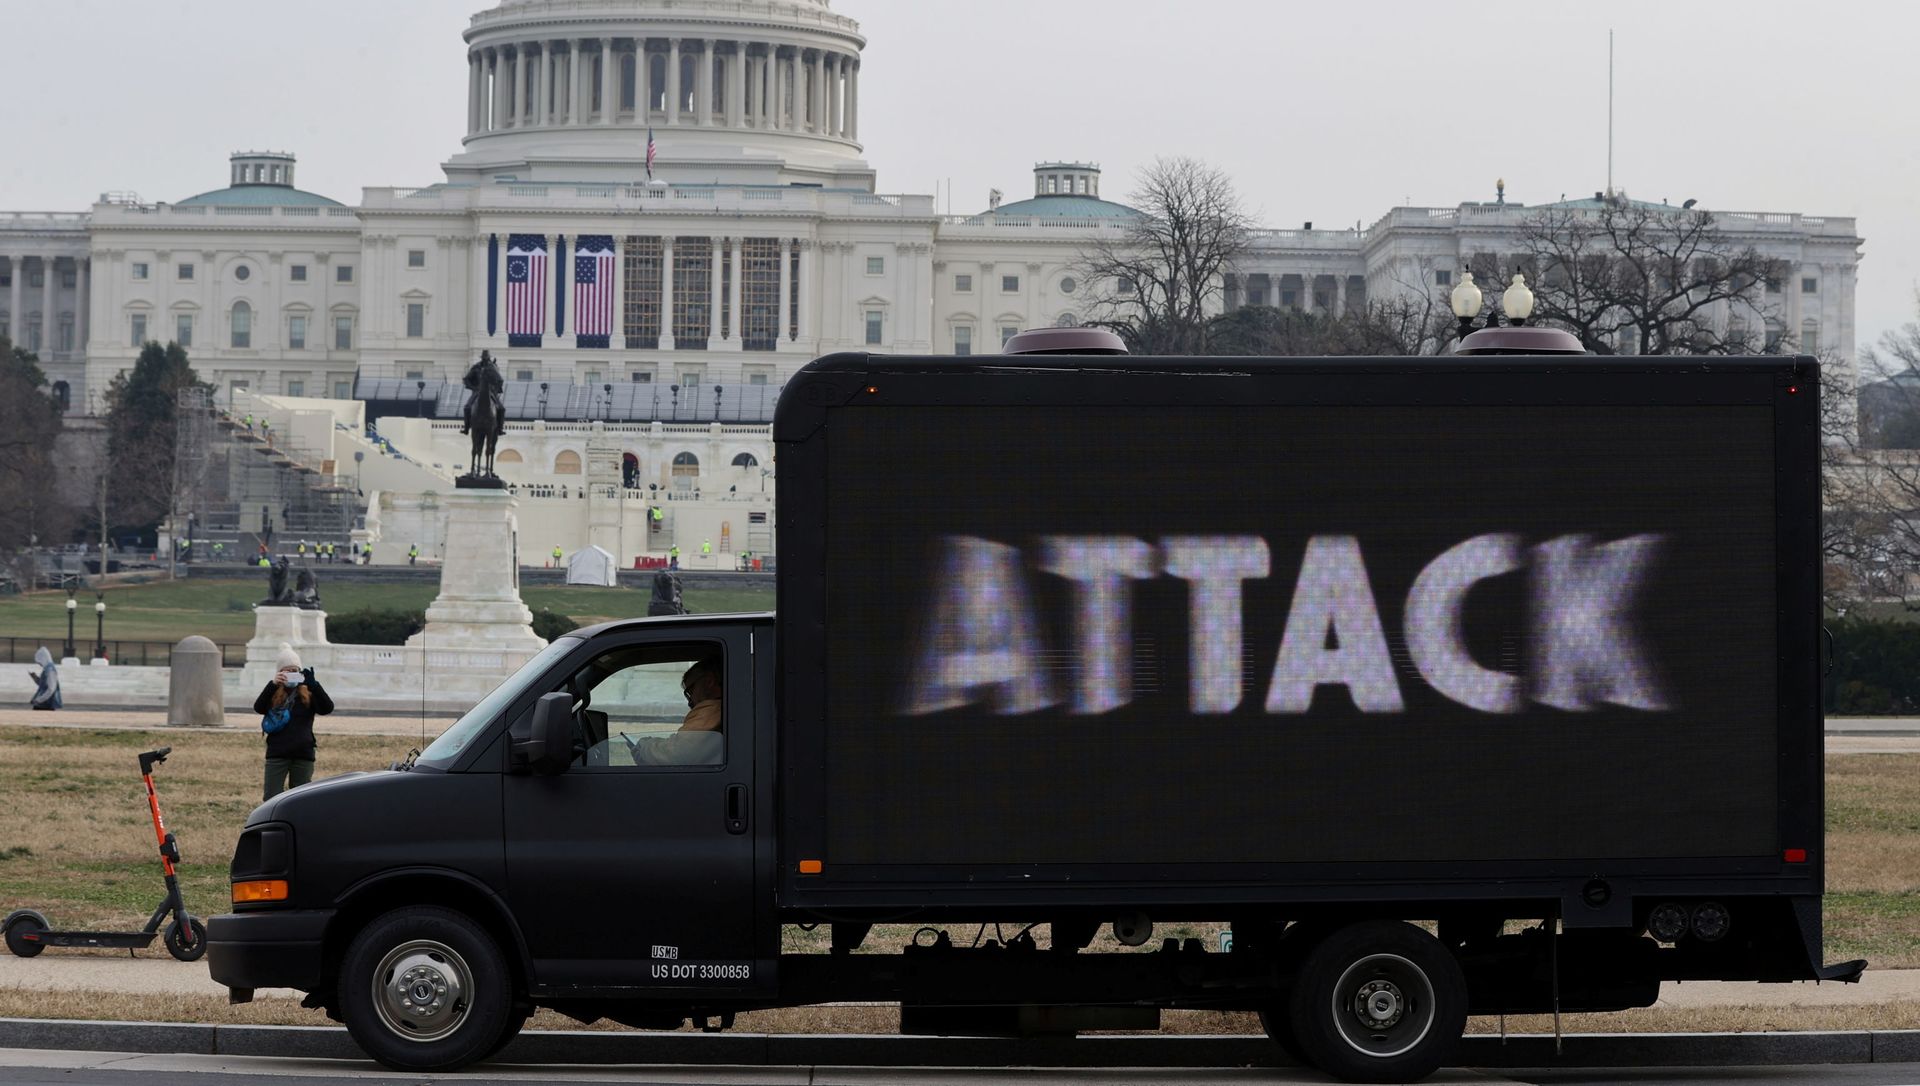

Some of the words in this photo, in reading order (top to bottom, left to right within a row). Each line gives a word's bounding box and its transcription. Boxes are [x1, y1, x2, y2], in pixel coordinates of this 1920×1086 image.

[907, 533, 1670, 713] ATTACK
[651, 945, 678, 960] USMB
[651, 964, 669, 978] US
[671, 964, 697, 978] DOT
[699, 964, 750, 979] 3300858
